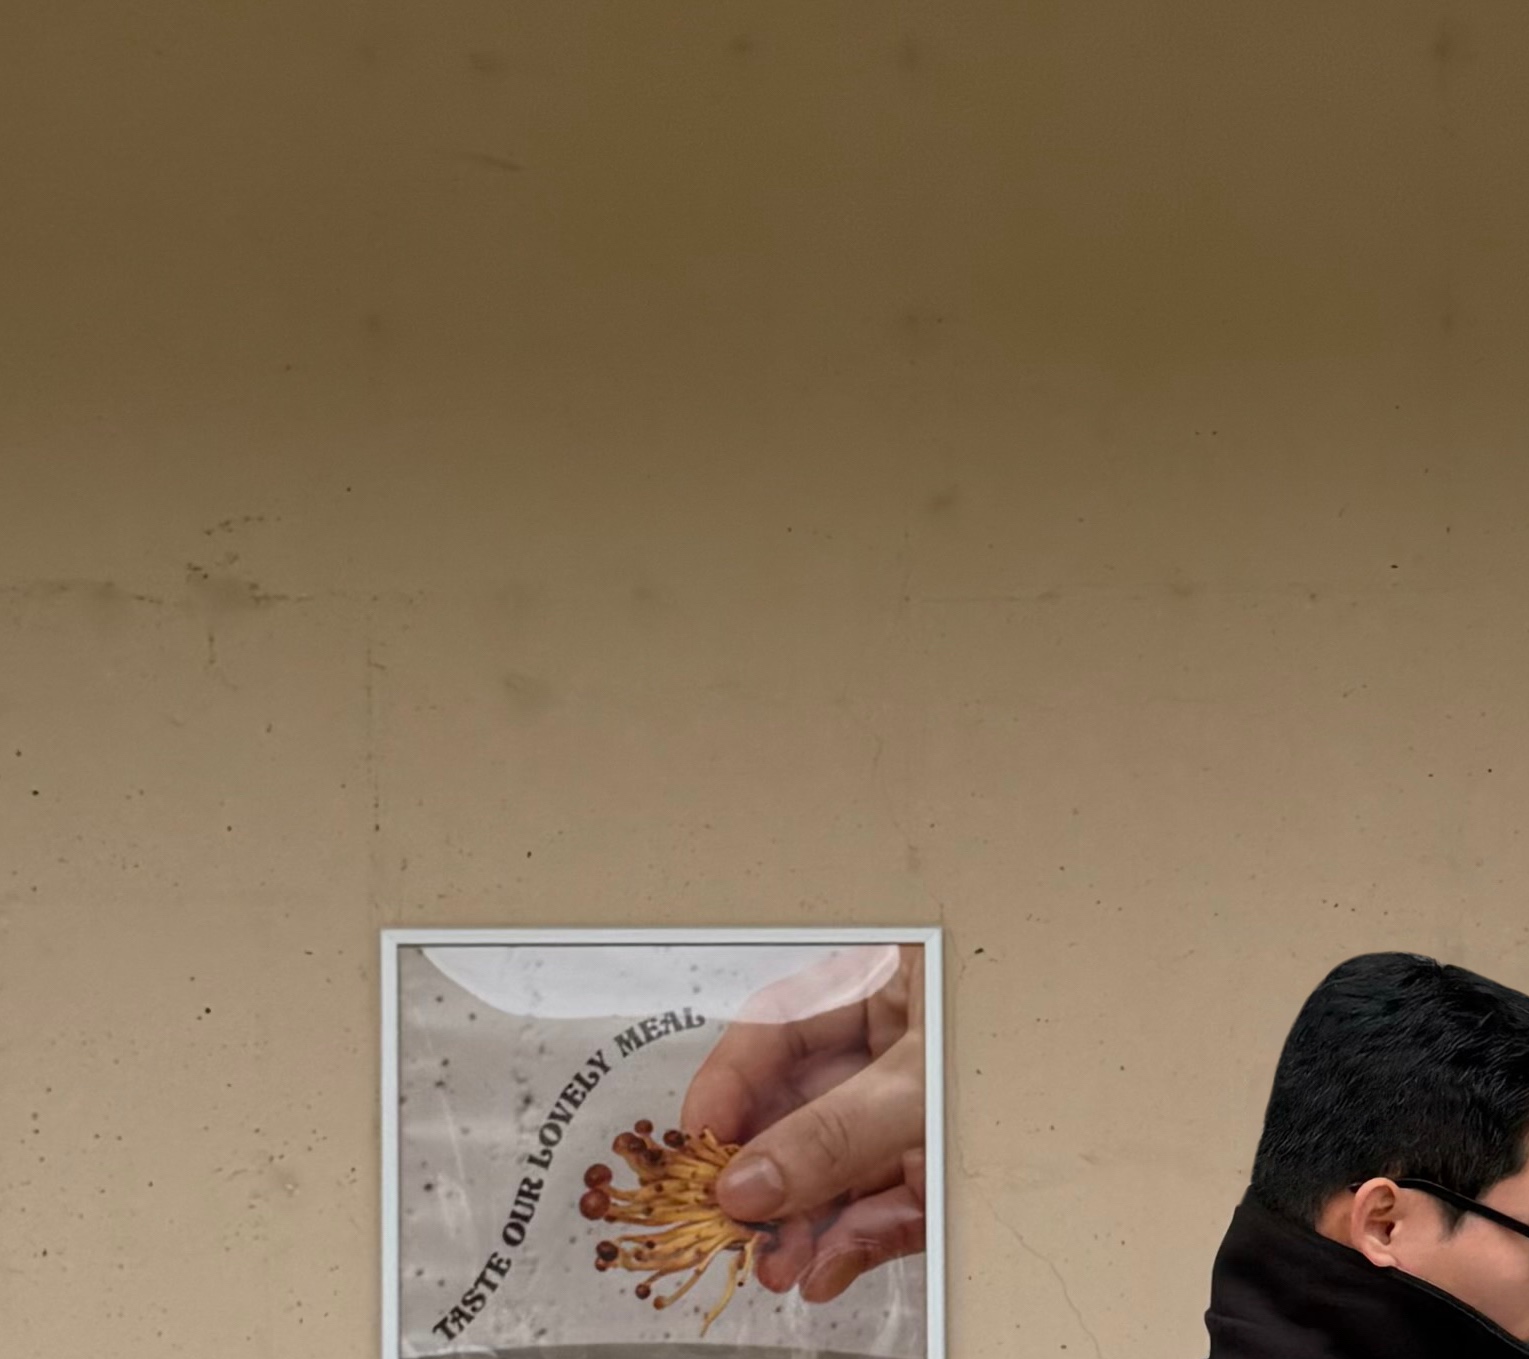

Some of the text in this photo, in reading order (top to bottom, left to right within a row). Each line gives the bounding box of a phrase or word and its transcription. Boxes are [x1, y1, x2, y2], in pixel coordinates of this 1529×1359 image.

[433, 1006, 706, 1342] TASTE OUR LOVELY MEAL
